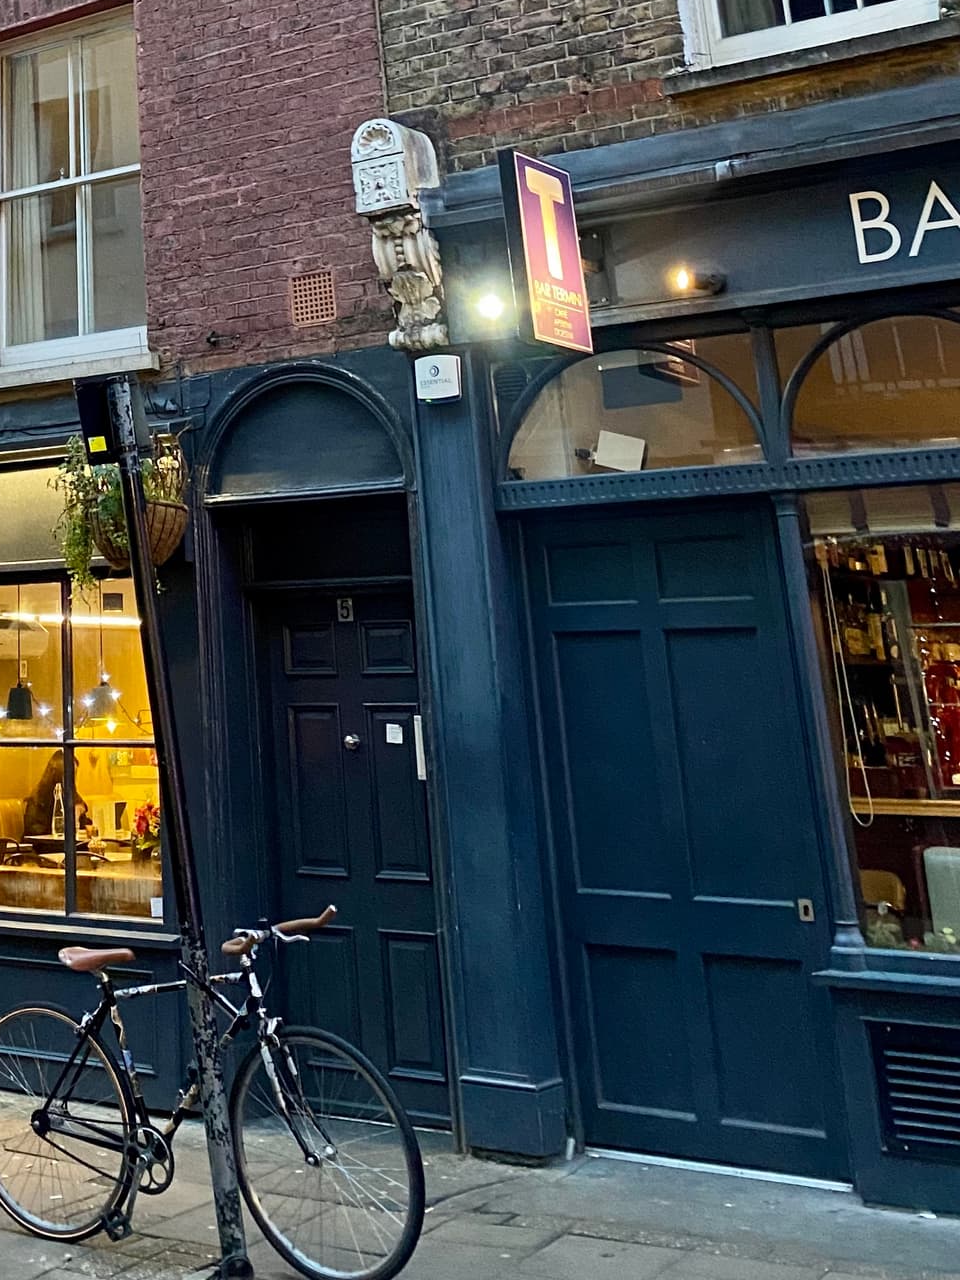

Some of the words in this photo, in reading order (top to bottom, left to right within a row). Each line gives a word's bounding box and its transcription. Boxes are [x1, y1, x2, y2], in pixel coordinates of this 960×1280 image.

[525, 166, 565, 280] T
[848, 179, 960, 265] BA
[534, 279, 551, 298] BAR
[340, 599, 350, 620] 5
